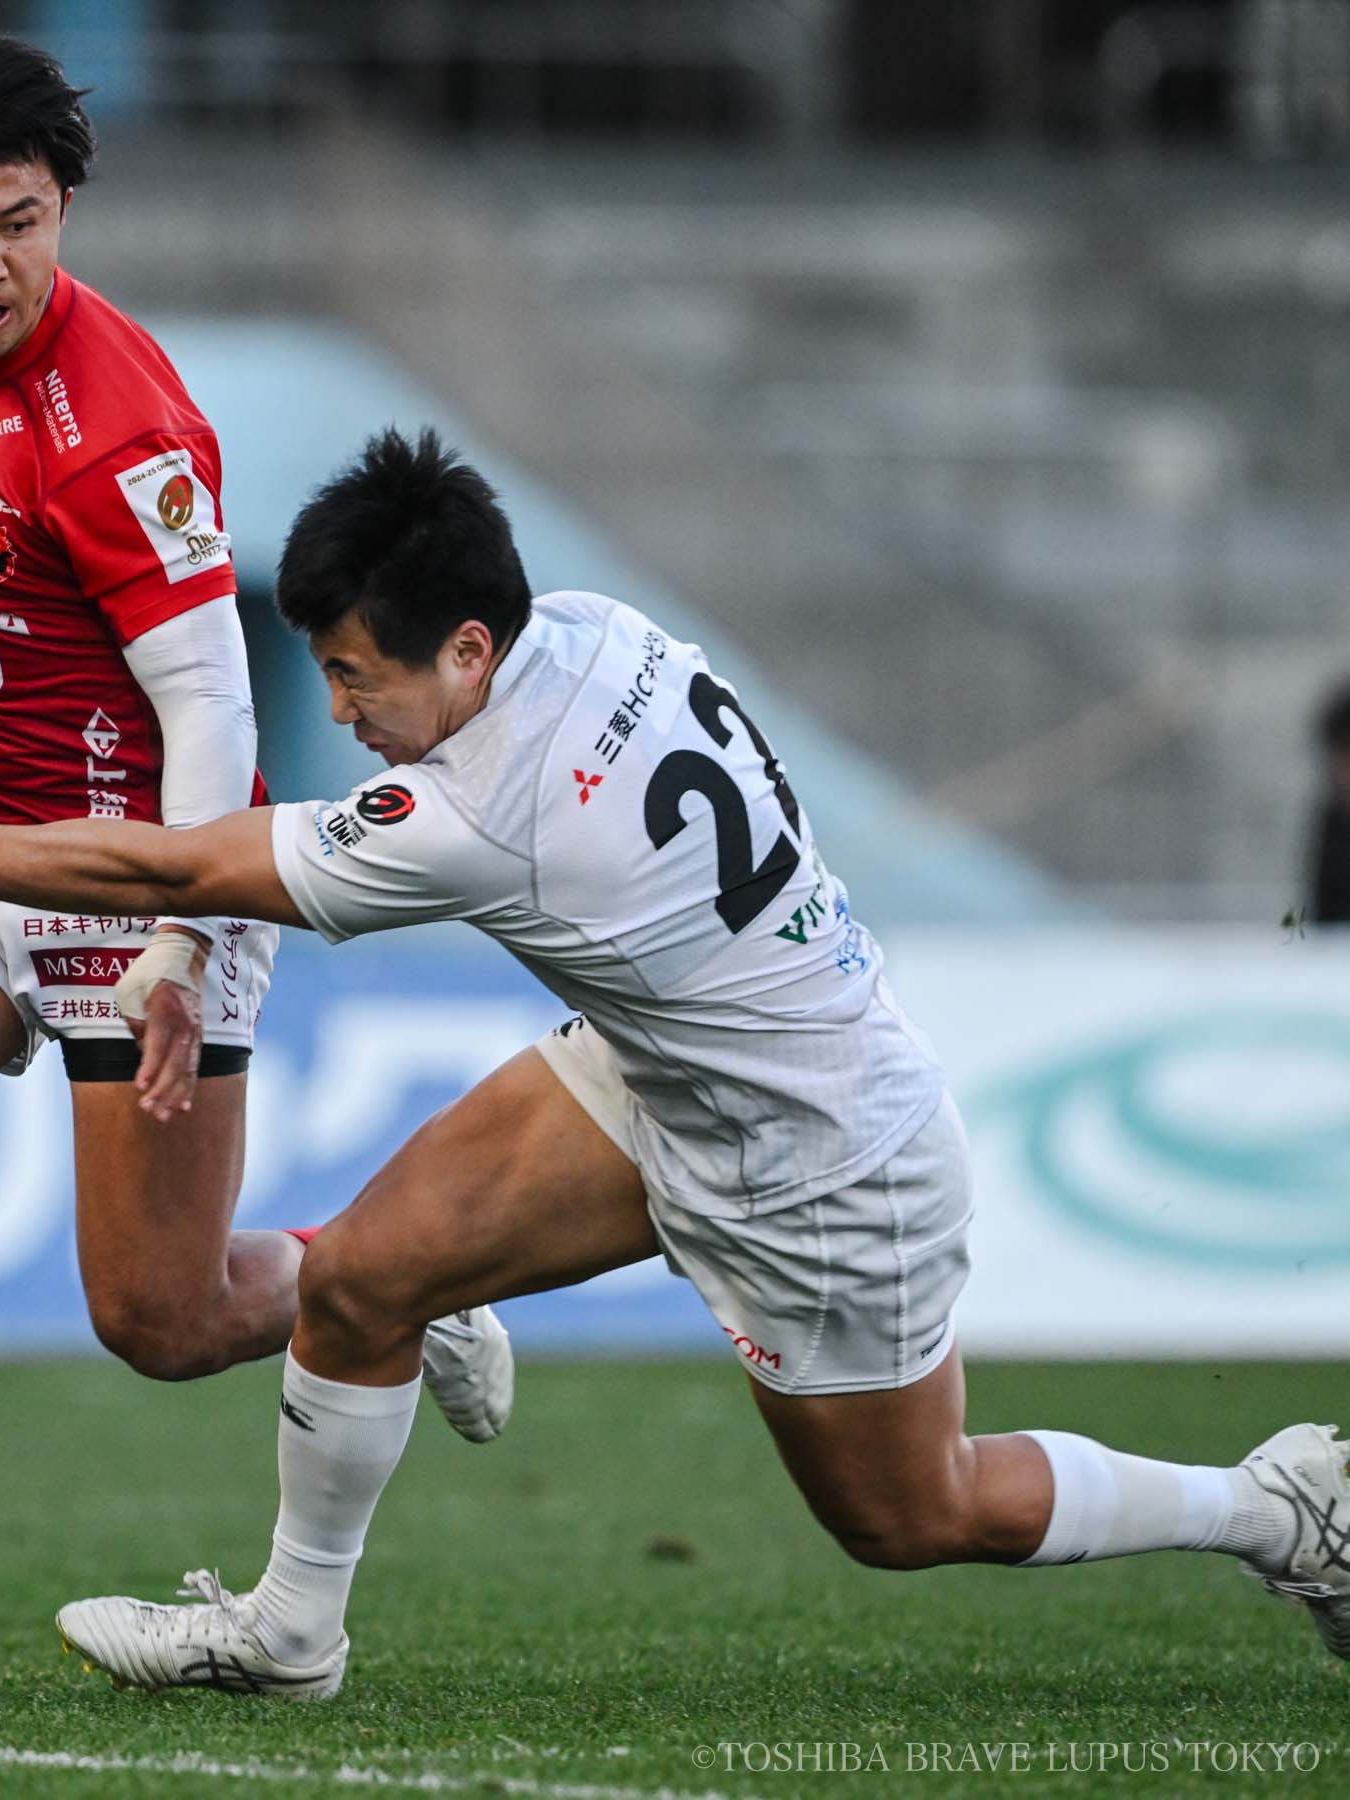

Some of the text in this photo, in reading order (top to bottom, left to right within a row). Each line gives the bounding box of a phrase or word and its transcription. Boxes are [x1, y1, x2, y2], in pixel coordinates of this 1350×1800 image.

[45, 368, 82, 448] Niterra
[644, 671, 801, 935] 22
[42, 956, 135, 977] MS&A
